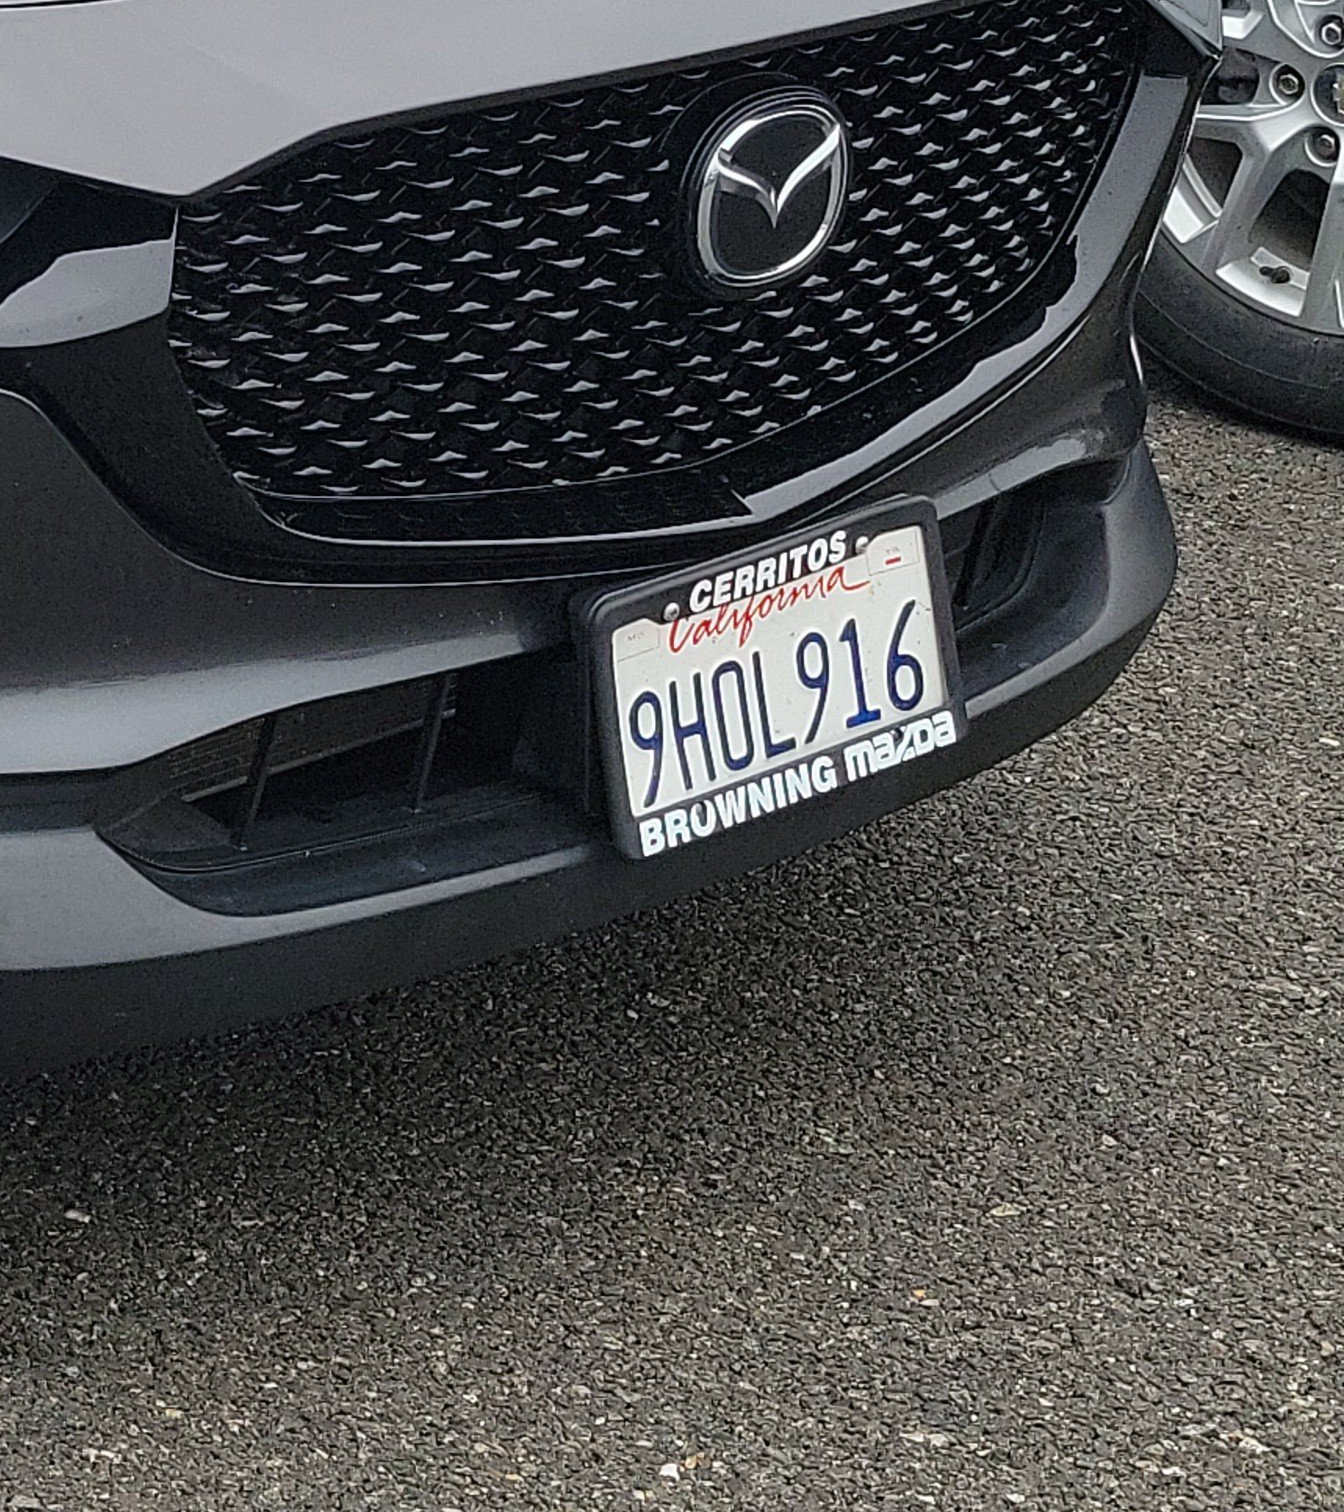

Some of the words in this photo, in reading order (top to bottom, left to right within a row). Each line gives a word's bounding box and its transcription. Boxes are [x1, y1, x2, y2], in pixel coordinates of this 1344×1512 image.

[669, 565, 871, 653] California
[689, 530, 847, 613] CERRITOS
[628, 599, 924, 808] 9HOL916
[639, 755, 838, 857] BROWNING
